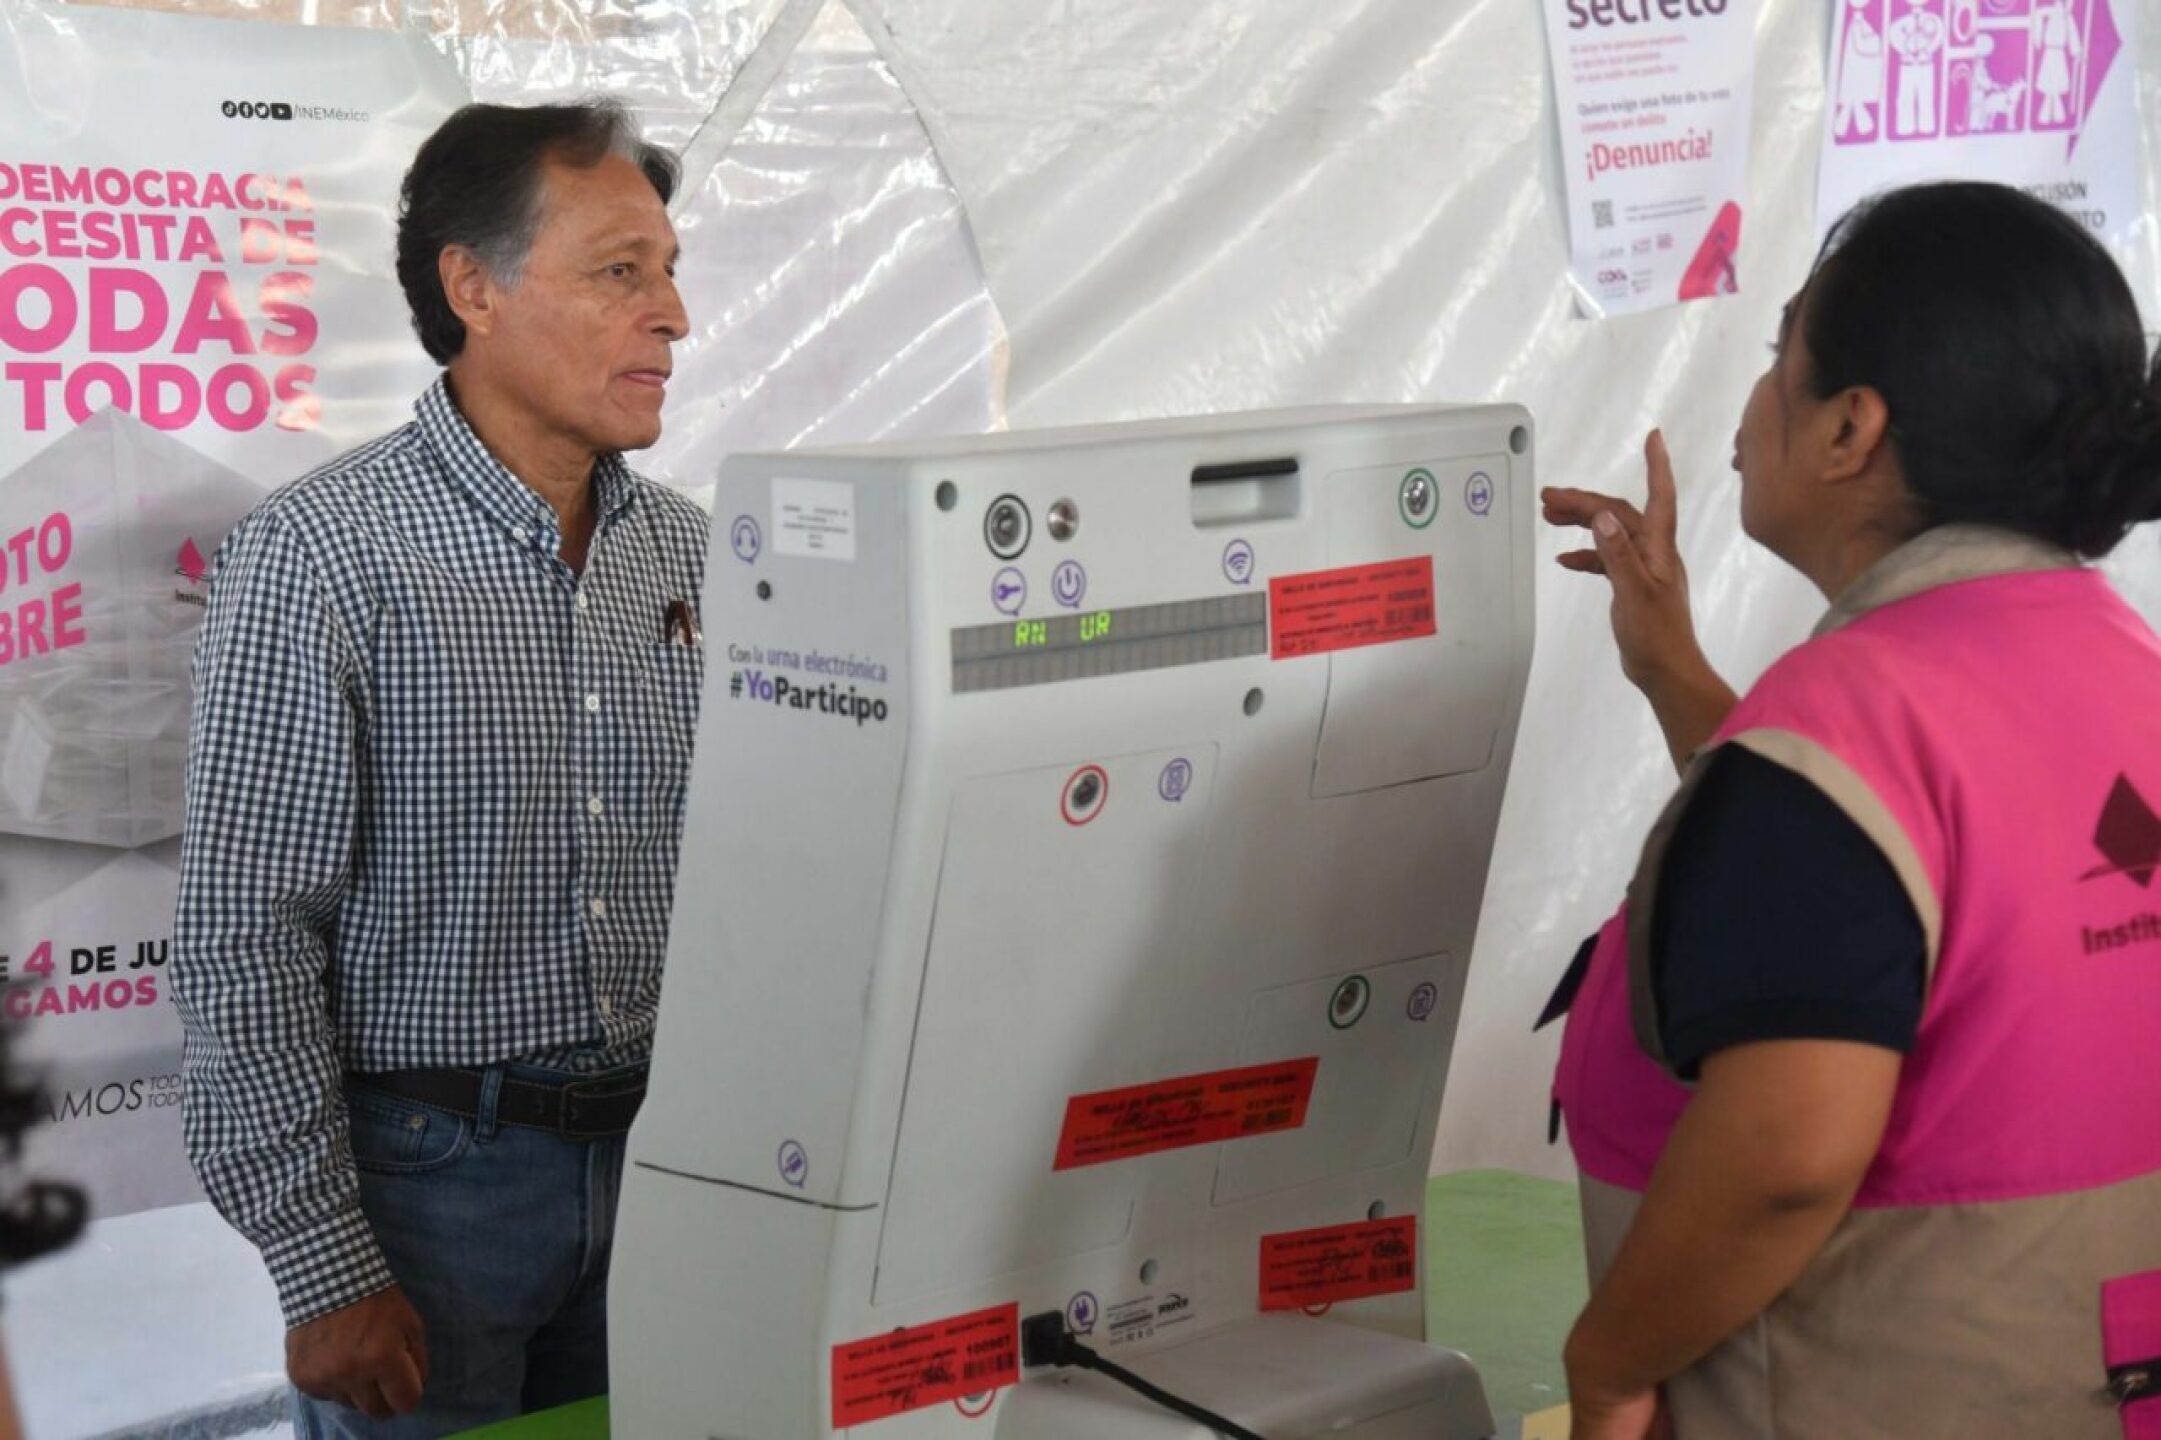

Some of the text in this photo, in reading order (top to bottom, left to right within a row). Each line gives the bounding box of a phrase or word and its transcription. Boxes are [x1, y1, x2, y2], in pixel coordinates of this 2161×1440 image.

[1585, 127, 1713, 181] ¡Denuncia!
[0, 207, 318, 266] CESITA DE
[0, 263, 318, 357] ODAS
[5, 361, 320, 432] TODOS
[1080, 611, 1111, 641] UR
[729, 643, 750, 662] Con
[768, 649, 799, 670] urna
[804, 649, 888, 682] electrónica
[731, 668, 887, 727] #YoParticipo
[24, 940, 55, 977] 4
[70, 945, 116, 975] DE
